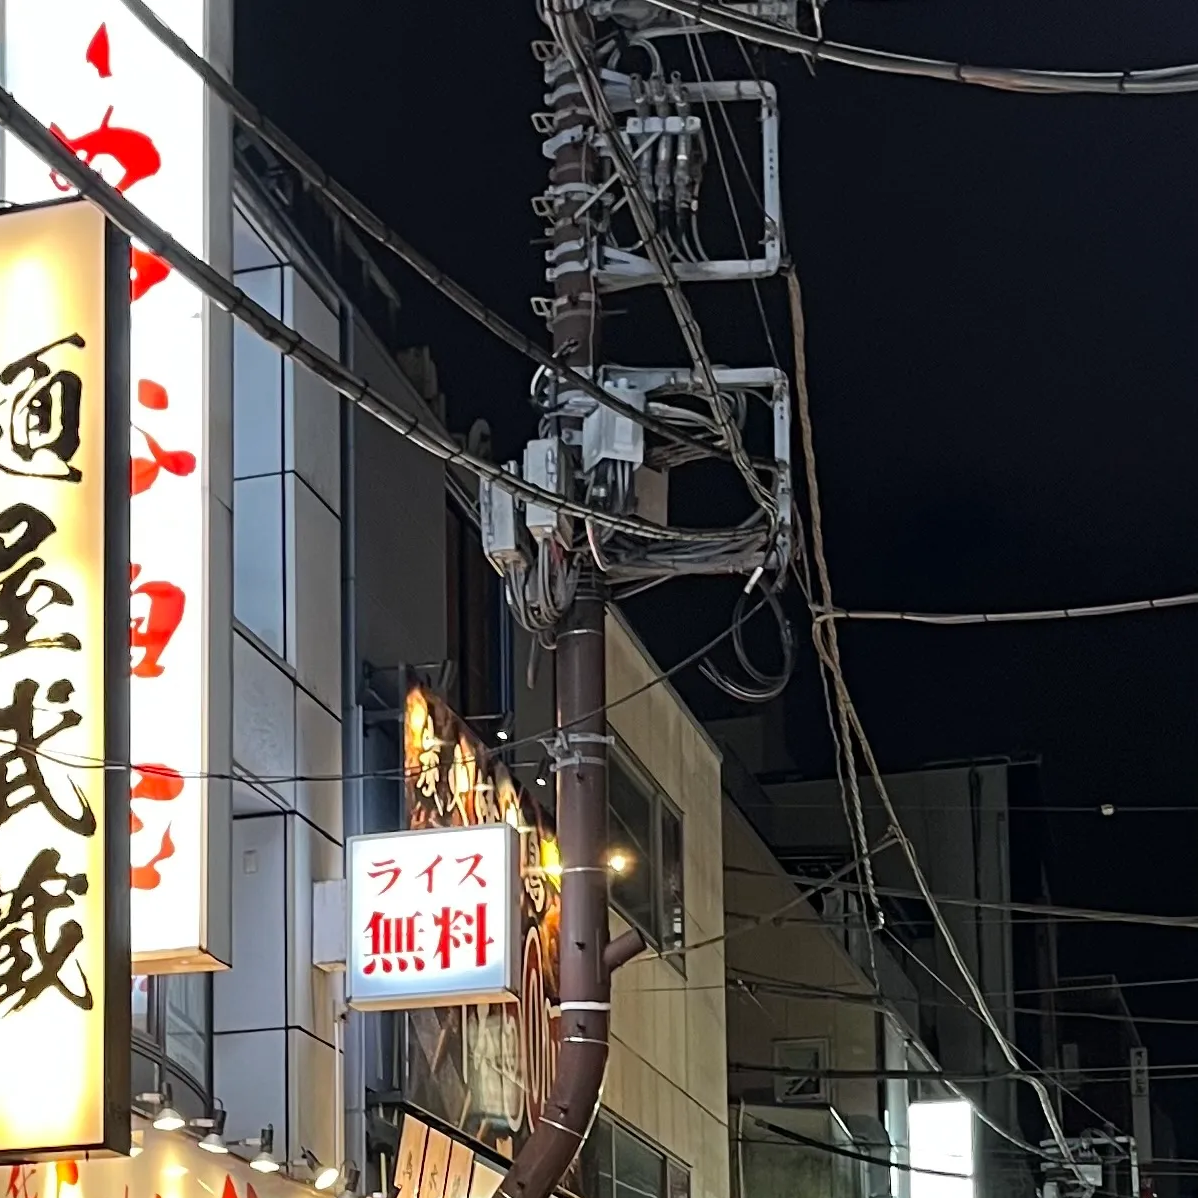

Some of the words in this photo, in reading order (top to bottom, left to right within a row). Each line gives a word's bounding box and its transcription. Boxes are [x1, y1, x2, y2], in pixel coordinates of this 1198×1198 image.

[366, 853, 487, 897] ライス
[362, 902, 495, 976] 無料
